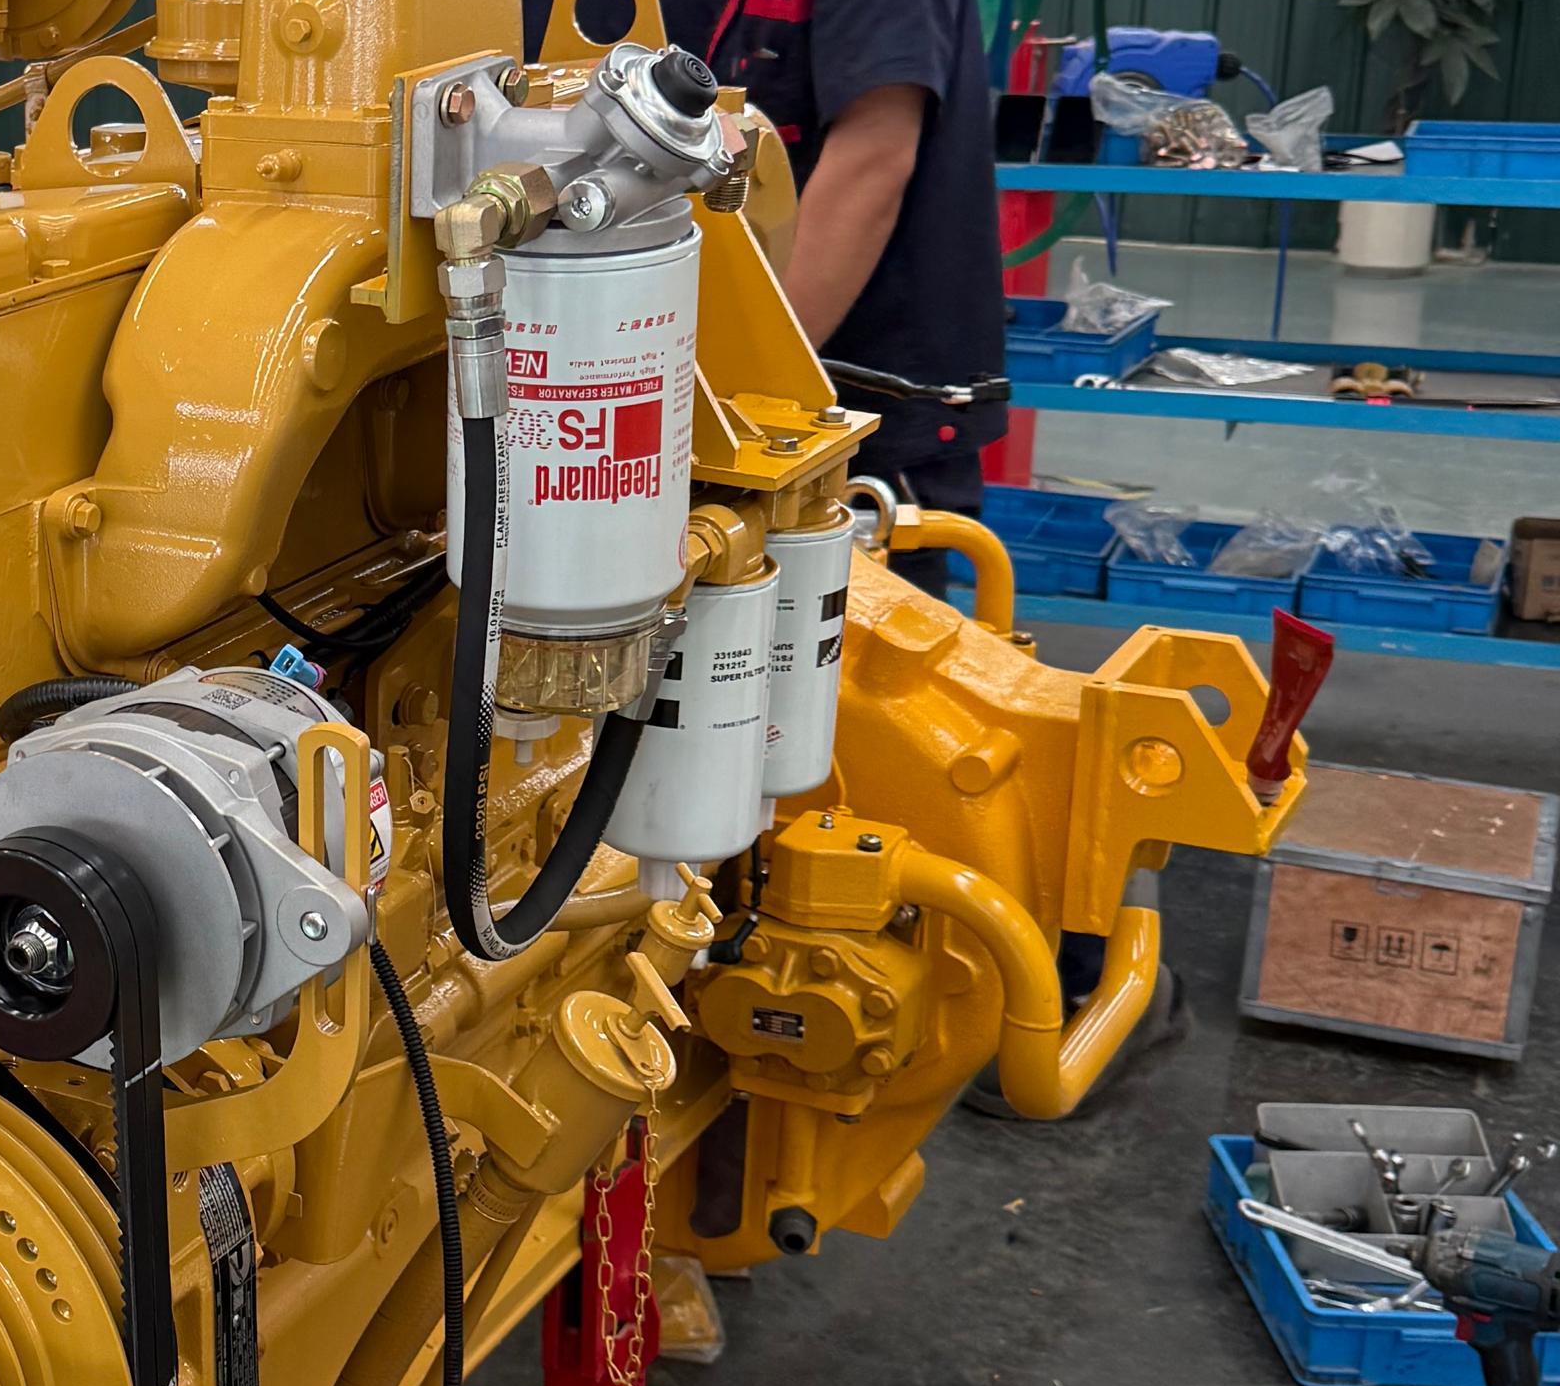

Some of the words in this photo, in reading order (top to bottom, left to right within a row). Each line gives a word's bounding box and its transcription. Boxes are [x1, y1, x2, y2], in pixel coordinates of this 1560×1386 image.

[538, 388, 598, 399] SEPARATOR
[496, 433, 507, 504] RESISTANT
[535, 454, 662, 506] Fleetguard
[496, 504, 506, 548] FLAME
[491, 590, 500, 616] MPa
[714, 648, 752, 660] 3315843
[711, 672, 741, 683] SUPER
[743, 666, 765, 680] FILTER
[712, 661, 747, 671] FS1212
[370, 787, 386, 809] GER
